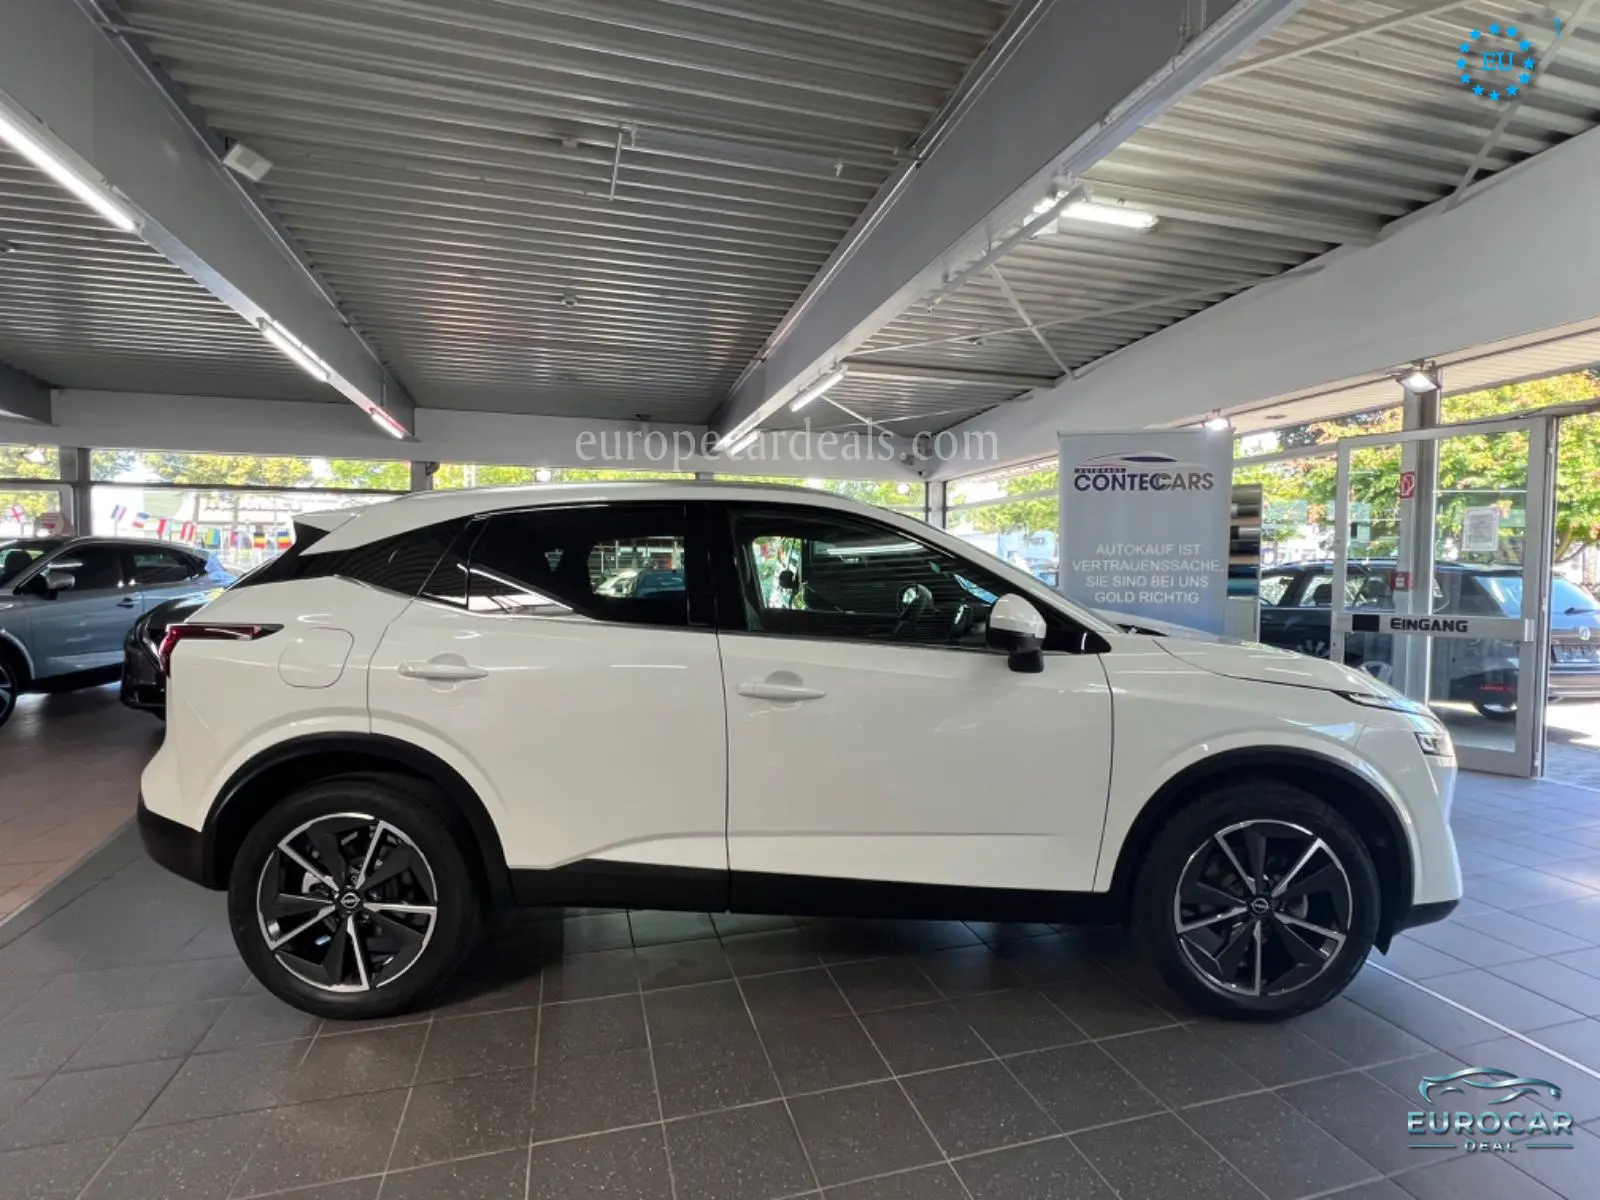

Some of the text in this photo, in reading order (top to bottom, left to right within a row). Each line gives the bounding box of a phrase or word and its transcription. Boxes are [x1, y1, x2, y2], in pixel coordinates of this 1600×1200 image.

[1096, 543, 1201, 555] AUTOKAUF IST
[1086, 575, 1209, 588] SIE SIND BEI UNS
[1094, 592, 1200, 604] GOLD RICHTIG
[1390, 617, 1468, 633] EINGANG
